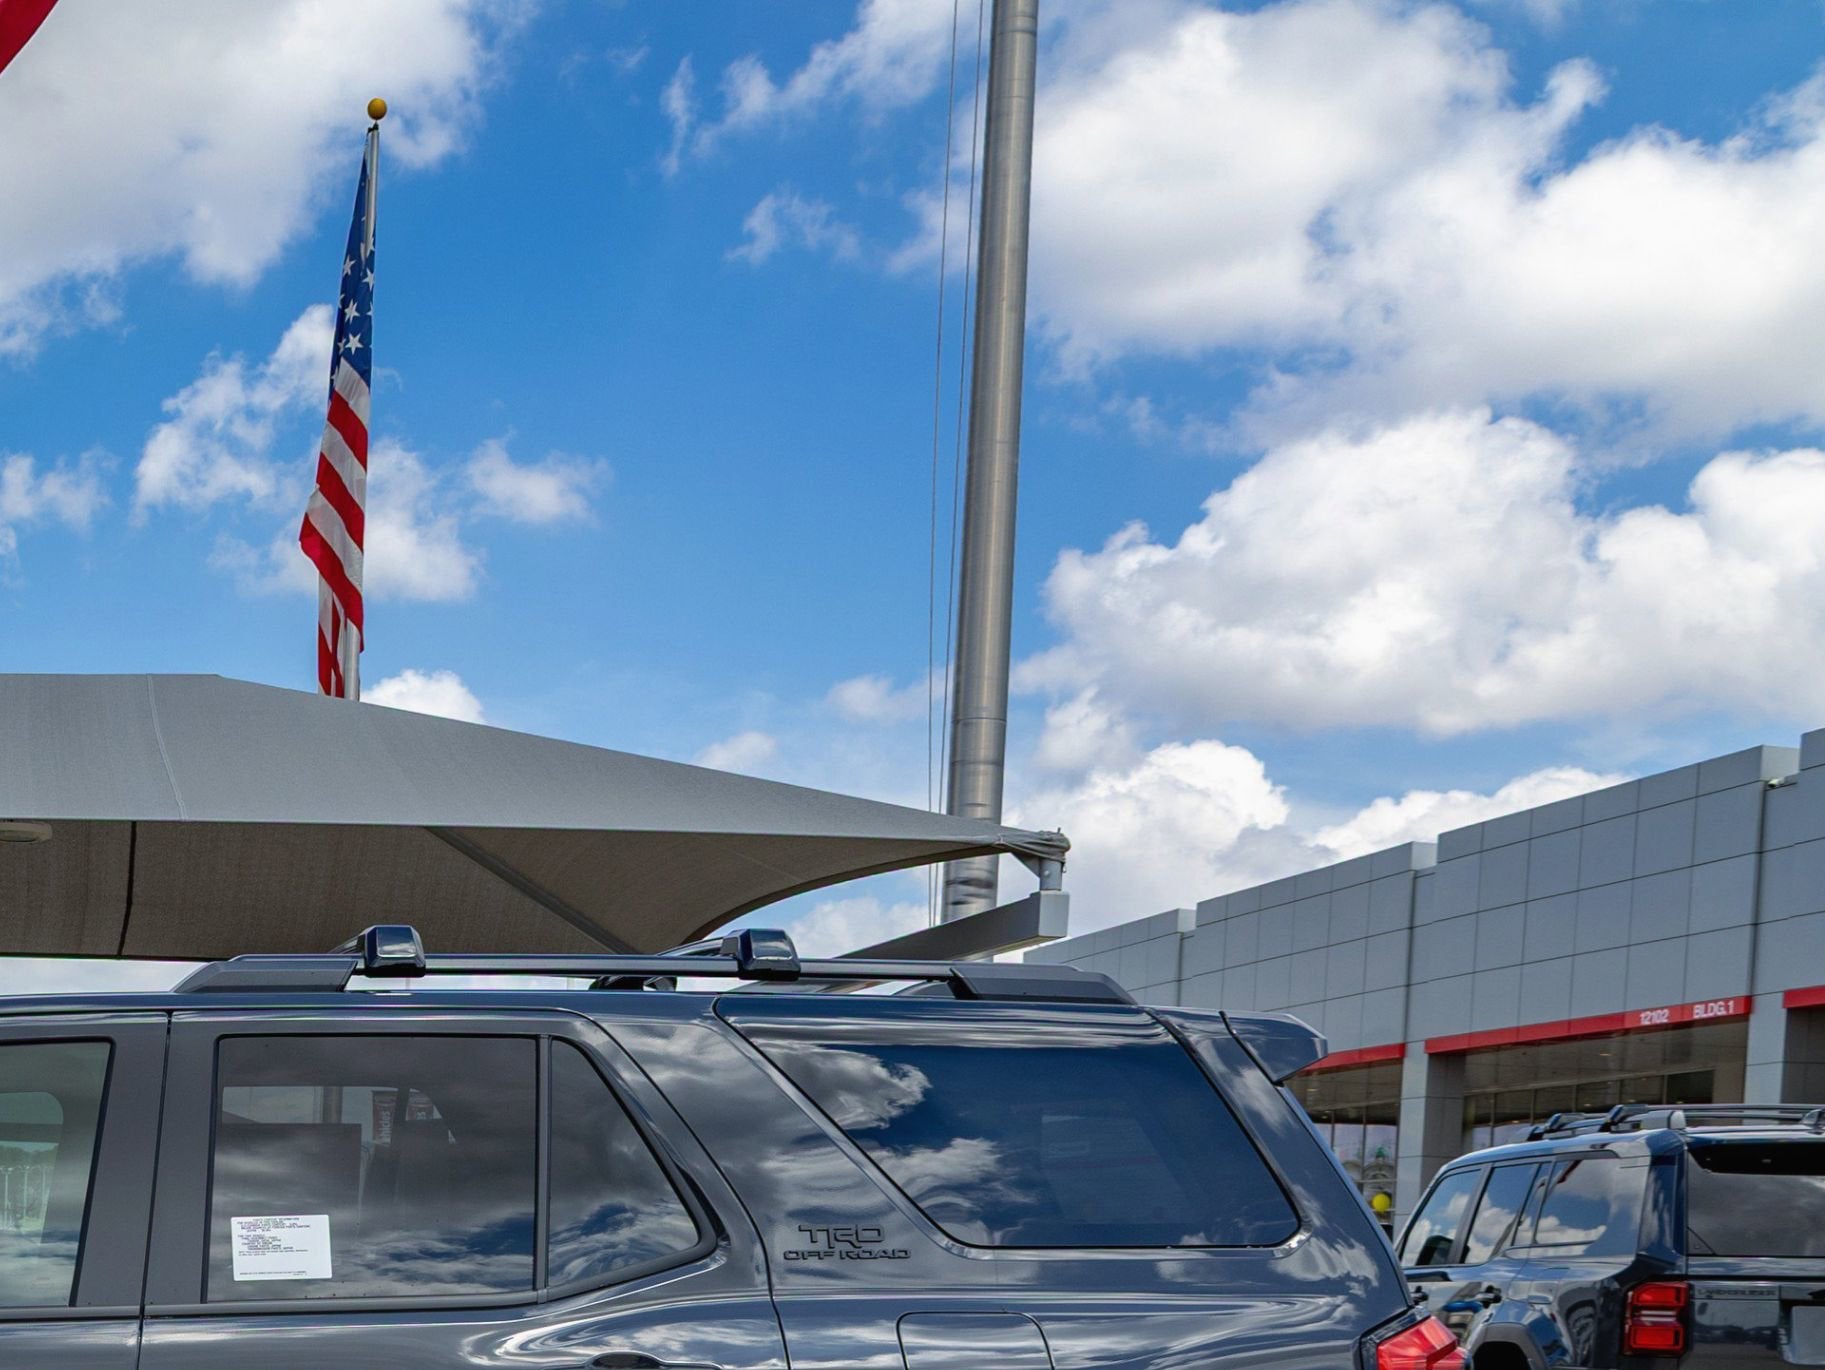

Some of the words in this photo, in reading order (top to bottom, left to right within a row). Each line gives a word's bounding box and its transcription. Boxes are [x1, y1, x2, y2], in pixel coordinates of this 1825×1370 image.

[1640, 1009, 1670, 1025] 12102
[798, 1223, 885, 1249] TRD
[783, 1250, 836, 1260] OFF
[839, 1249, 912, 1260] ROAD
